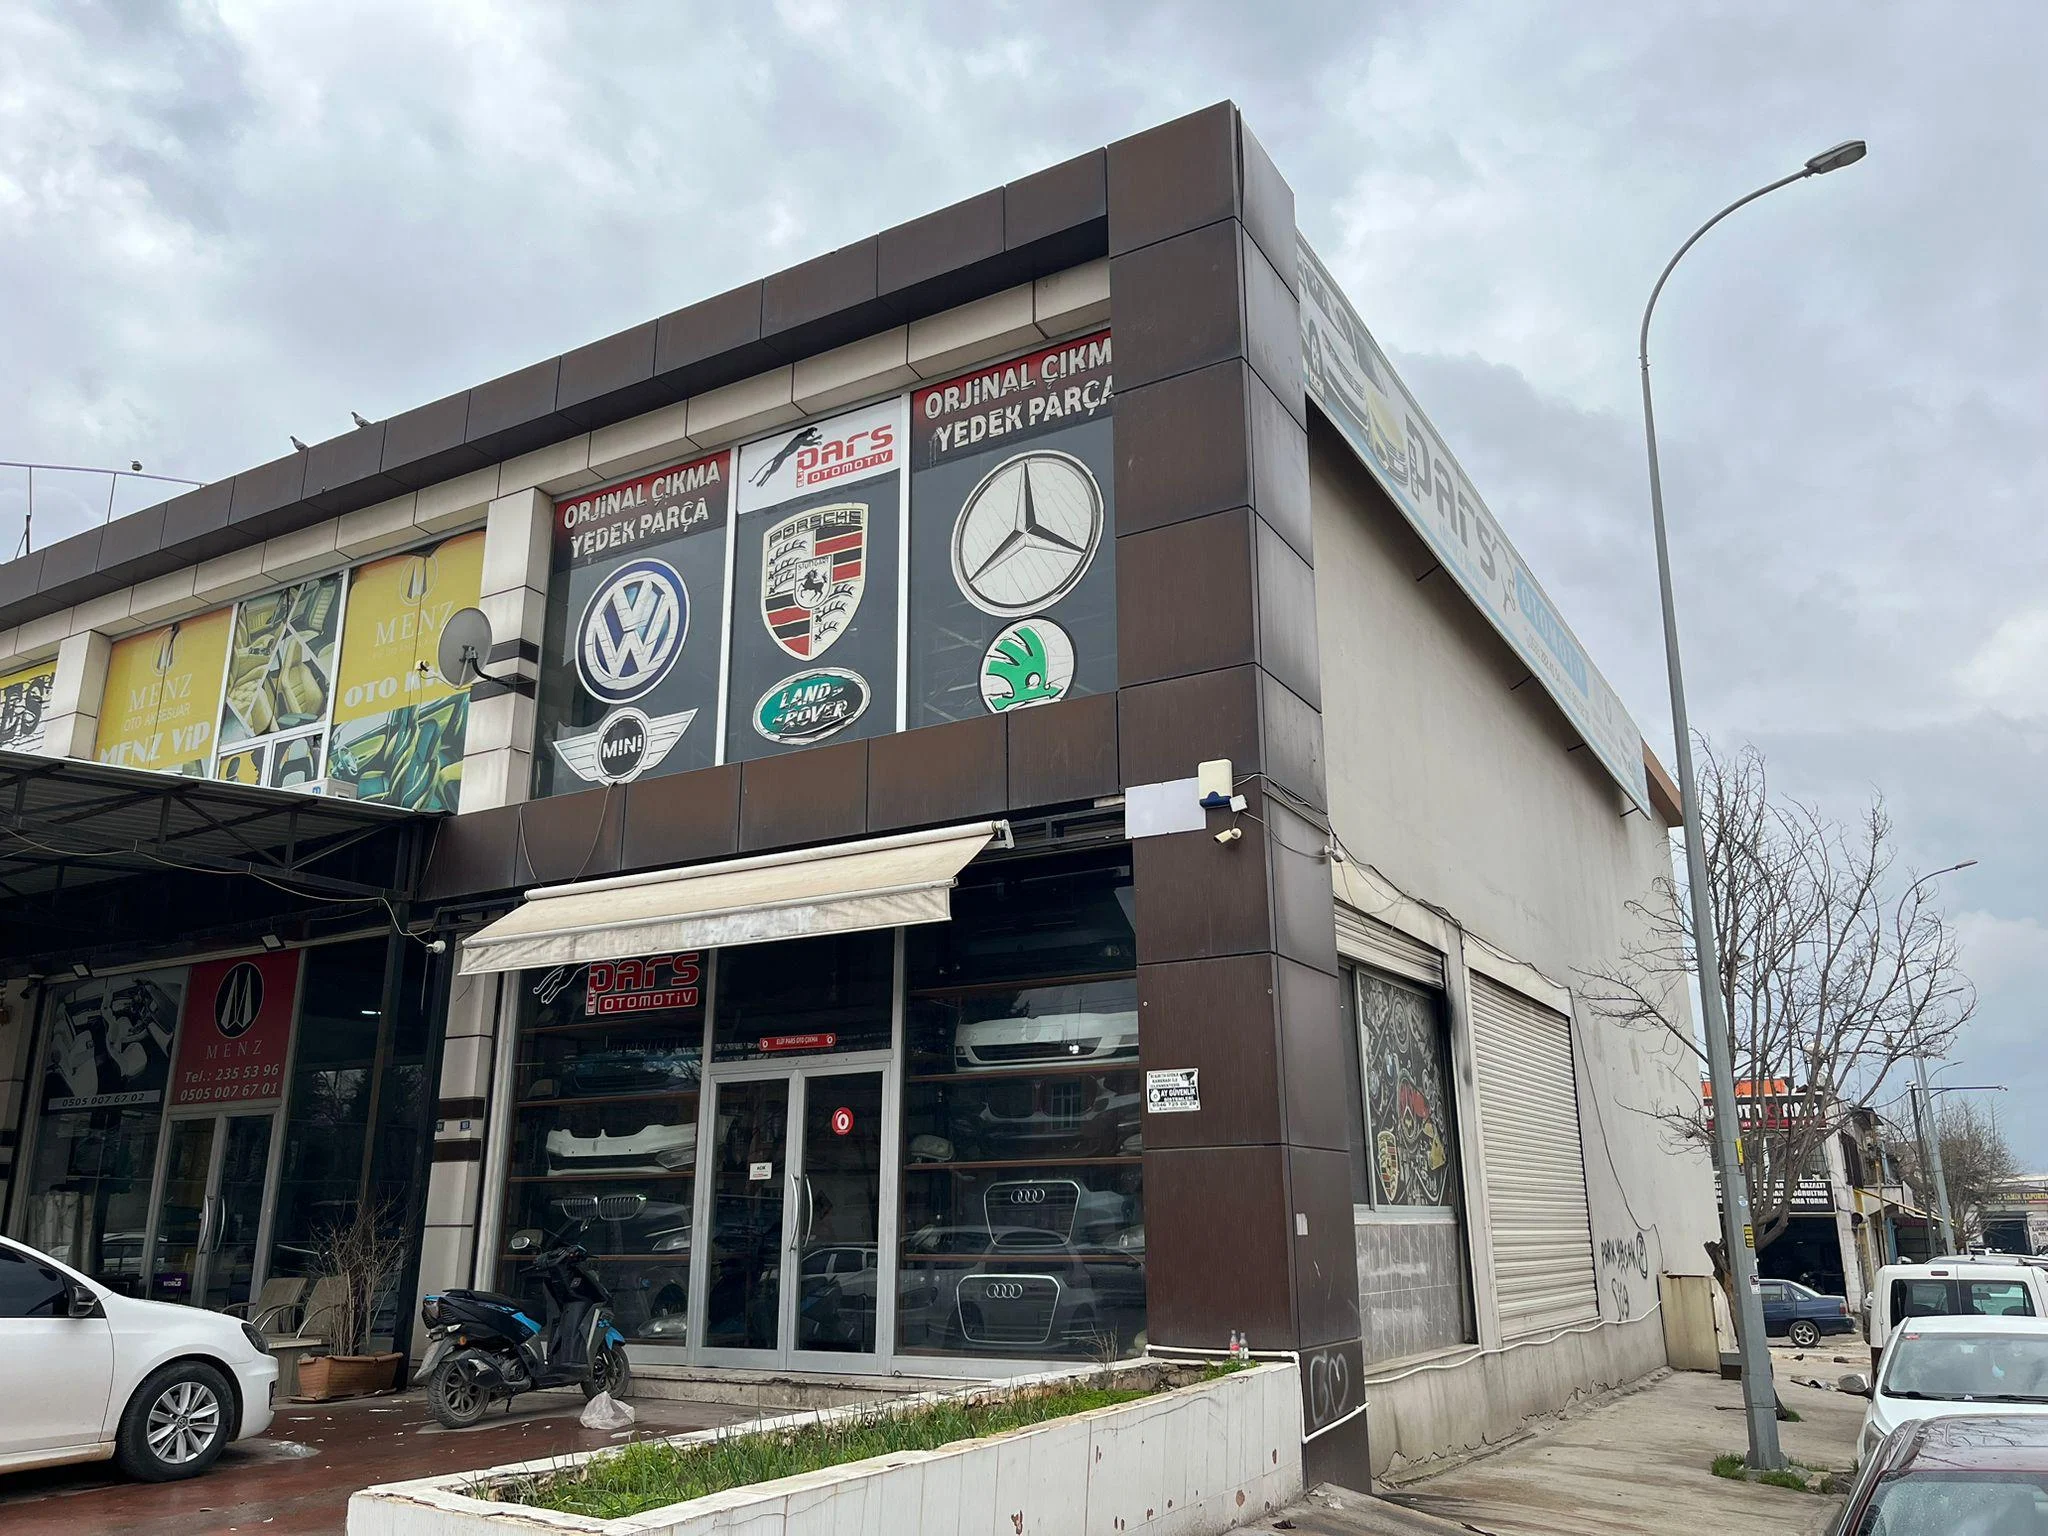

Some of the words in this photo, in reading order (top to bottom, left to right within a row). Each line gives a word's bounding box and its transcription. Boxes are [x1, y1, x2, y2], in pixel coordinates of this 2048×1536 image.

[1041, 337, 1113, 389] ÇIKM
[937, 404, 1022, 452] YEDEK
[651, 460, 720, 504] ÇIKMA
[571, 520, 636, 559] YEDEK
[640, 498, 709, 538] PARÇA
[769, 510, 862, 547] PORSCHE
[128, 673, 193, 713] MENZ
[344, 676, 398, 708] OTO
[779, 682, 833, 710] LAND
[124, 716, 142, 732] OTO
[144, 703, 190, 726] AKSESUAR
[782, 701, 848, 731] ROVER
[602, 735, 643, 759] MINI
[206, 1040, 263, 1060] MENZ
[215, 1067, 239, 1081] 235
[243, 1065, 259, 1079] 53
[261, 1063, 279, 1077] 96
[62, 1097, 88, 1107] 0505
[91, 1095, 112, 1105] 007
[114, 1094, 129, 1103] 67
[131, 1092, 145, 1102] 02
[180, 1087, 210, 1101] 0505
[215, 1085, 239, 1099] 007
[242, 1083, 258, 1097] 67
[262, 1082, 278, 1095] 01
[1161, 1089, 1168, 1097] AY
[1792, 1189, 1829, 1197] OĞRULTMA
